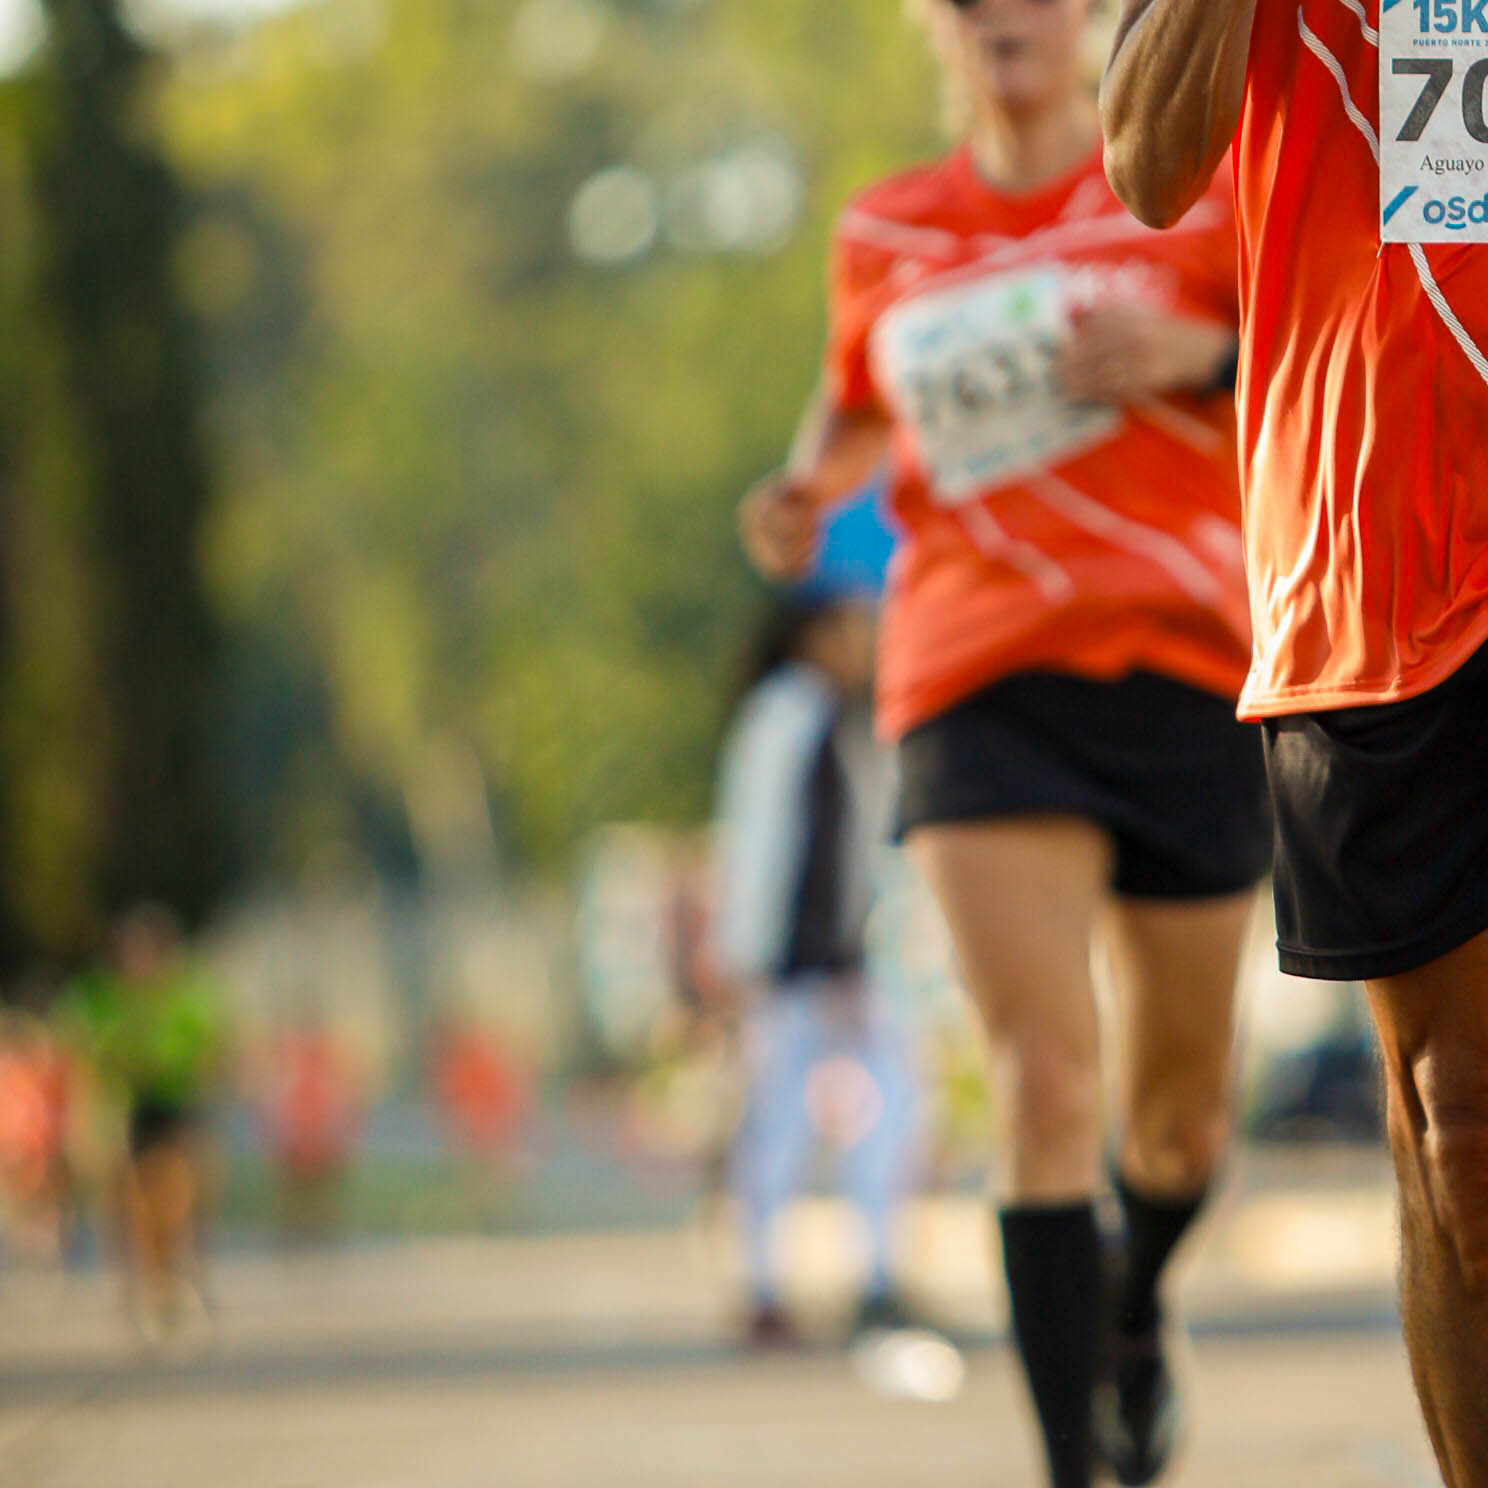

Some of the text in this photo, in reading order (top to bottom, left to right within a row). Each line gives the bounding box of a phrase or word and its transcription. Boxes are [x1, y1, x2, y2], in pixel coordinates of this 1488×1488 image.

[1413, 39, 1448, 47] PUERTO
[1452, 39, 1480, 47] NORTE
[1420, 154, 1485, 175] Aguayo
